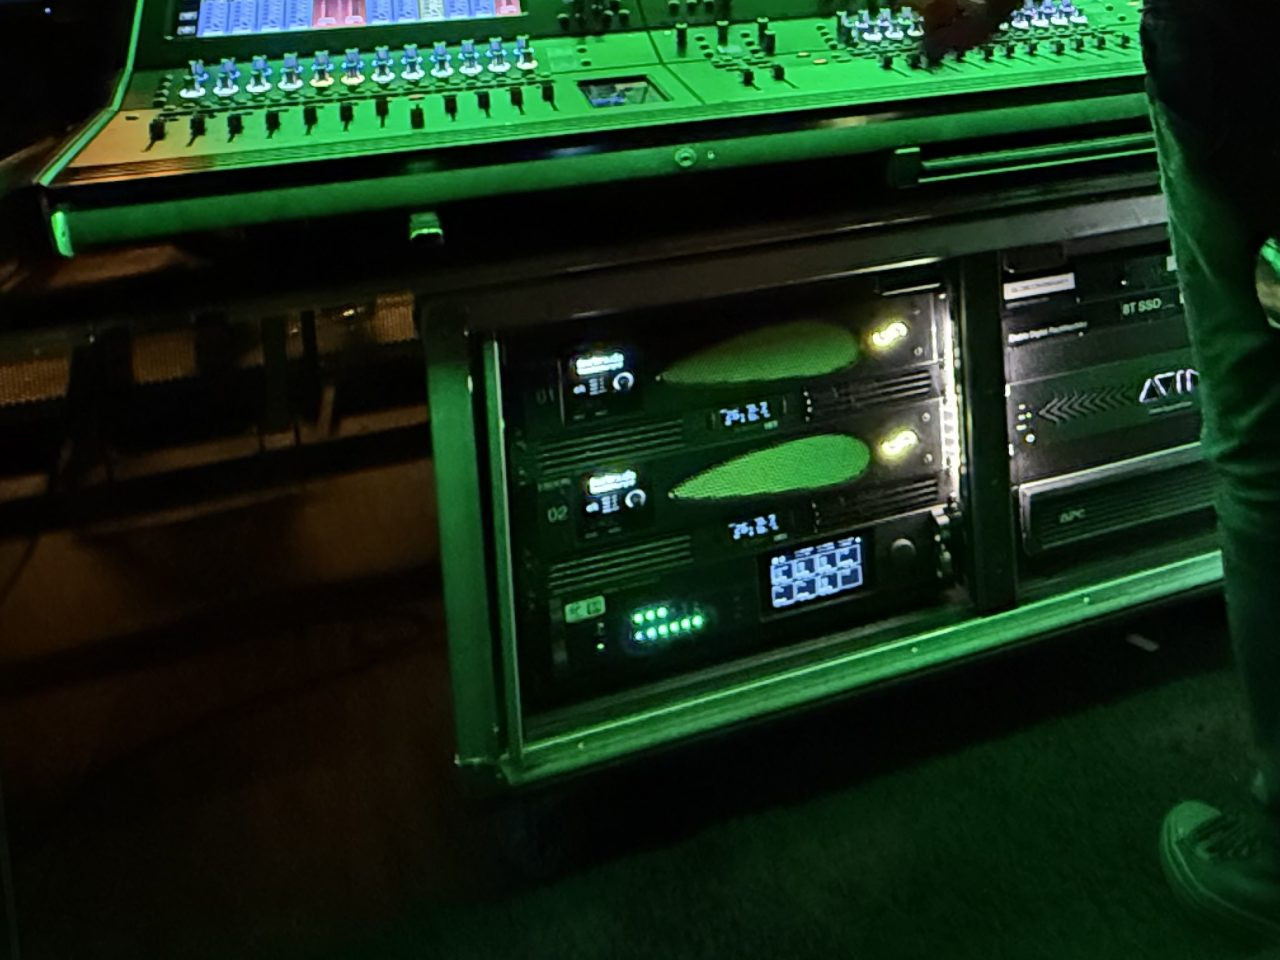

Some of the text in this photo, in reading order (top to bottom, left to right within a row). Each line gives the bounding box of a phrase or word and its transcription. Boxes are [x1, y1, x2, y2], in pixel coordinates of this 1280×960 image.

[1137, 297, 1163, 312] SSD
[547, 505, 569, 523] 02
[1058, 508, 1087, 524] APC
